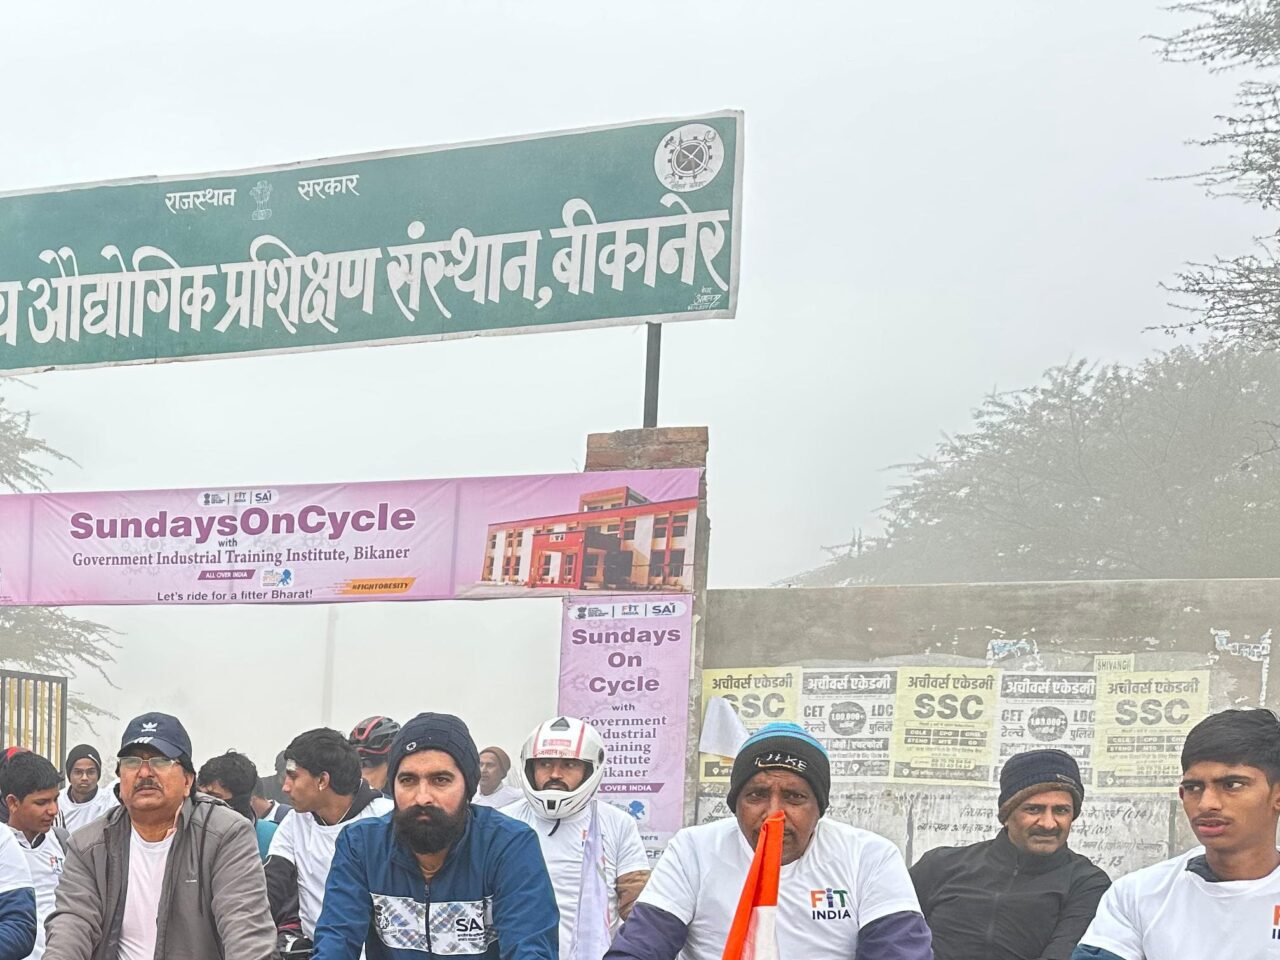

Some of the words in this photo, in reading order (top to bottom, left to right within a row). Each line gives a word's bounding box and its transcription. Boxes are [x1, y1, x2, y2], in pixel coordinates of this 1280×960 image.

[165, 187, 237, 214] राजस्थान
[298, 174, 360, 200] सरकार
[27, 245, 219, 344] औद्योगिक
[214, 234, 383, 335] प्रशिक्षण
[387, 220, 553, 322] संस्थान,
[550, 193, 730, 295] बीकानेर
[70, 503, 416, 544] SundaysOnCycle
[218, 538, 238, 548] with
[72, 552, 154, 567] Government
[156, 550, 222, 566] Industrial
[225, 550, 283, 567] Training
[286, 548, 350, 565] Institute,
[353, 546, 410, 560] Bikaner
[157, 592, 184, 602] Let's
[187, 592, 209, 602] ride
[211, 592, 227, 601] for
[241, 590, 269, 601] fitter
[271, 589, 313, 600] Bharat!
[572, 627, 681, 646] Sundays
[607, 651, 642, 668] On
[589, 676, 660, 696] Cycle
[712, 673, 752, 690] अचीवर्स
[807, 673, 850, 690] अचीवर्स
[907, 674, 952, 690] अचीवर्स
[804, 705, 824, 717] CET
[871, 704, 894, 717] LDC
[913, 693, 984, 720] SSC
[1001, 709, 1024, 721] CET
[1115, 698, 1190, 726] SSC
[606, 754, 651, 765] stitute
[603, 767, 649, 778] ikaner
[605, 784, 627, 792] OVER
[629, 784, 652, 792] INDIA
[812, 909, 852, 920] INDIA
